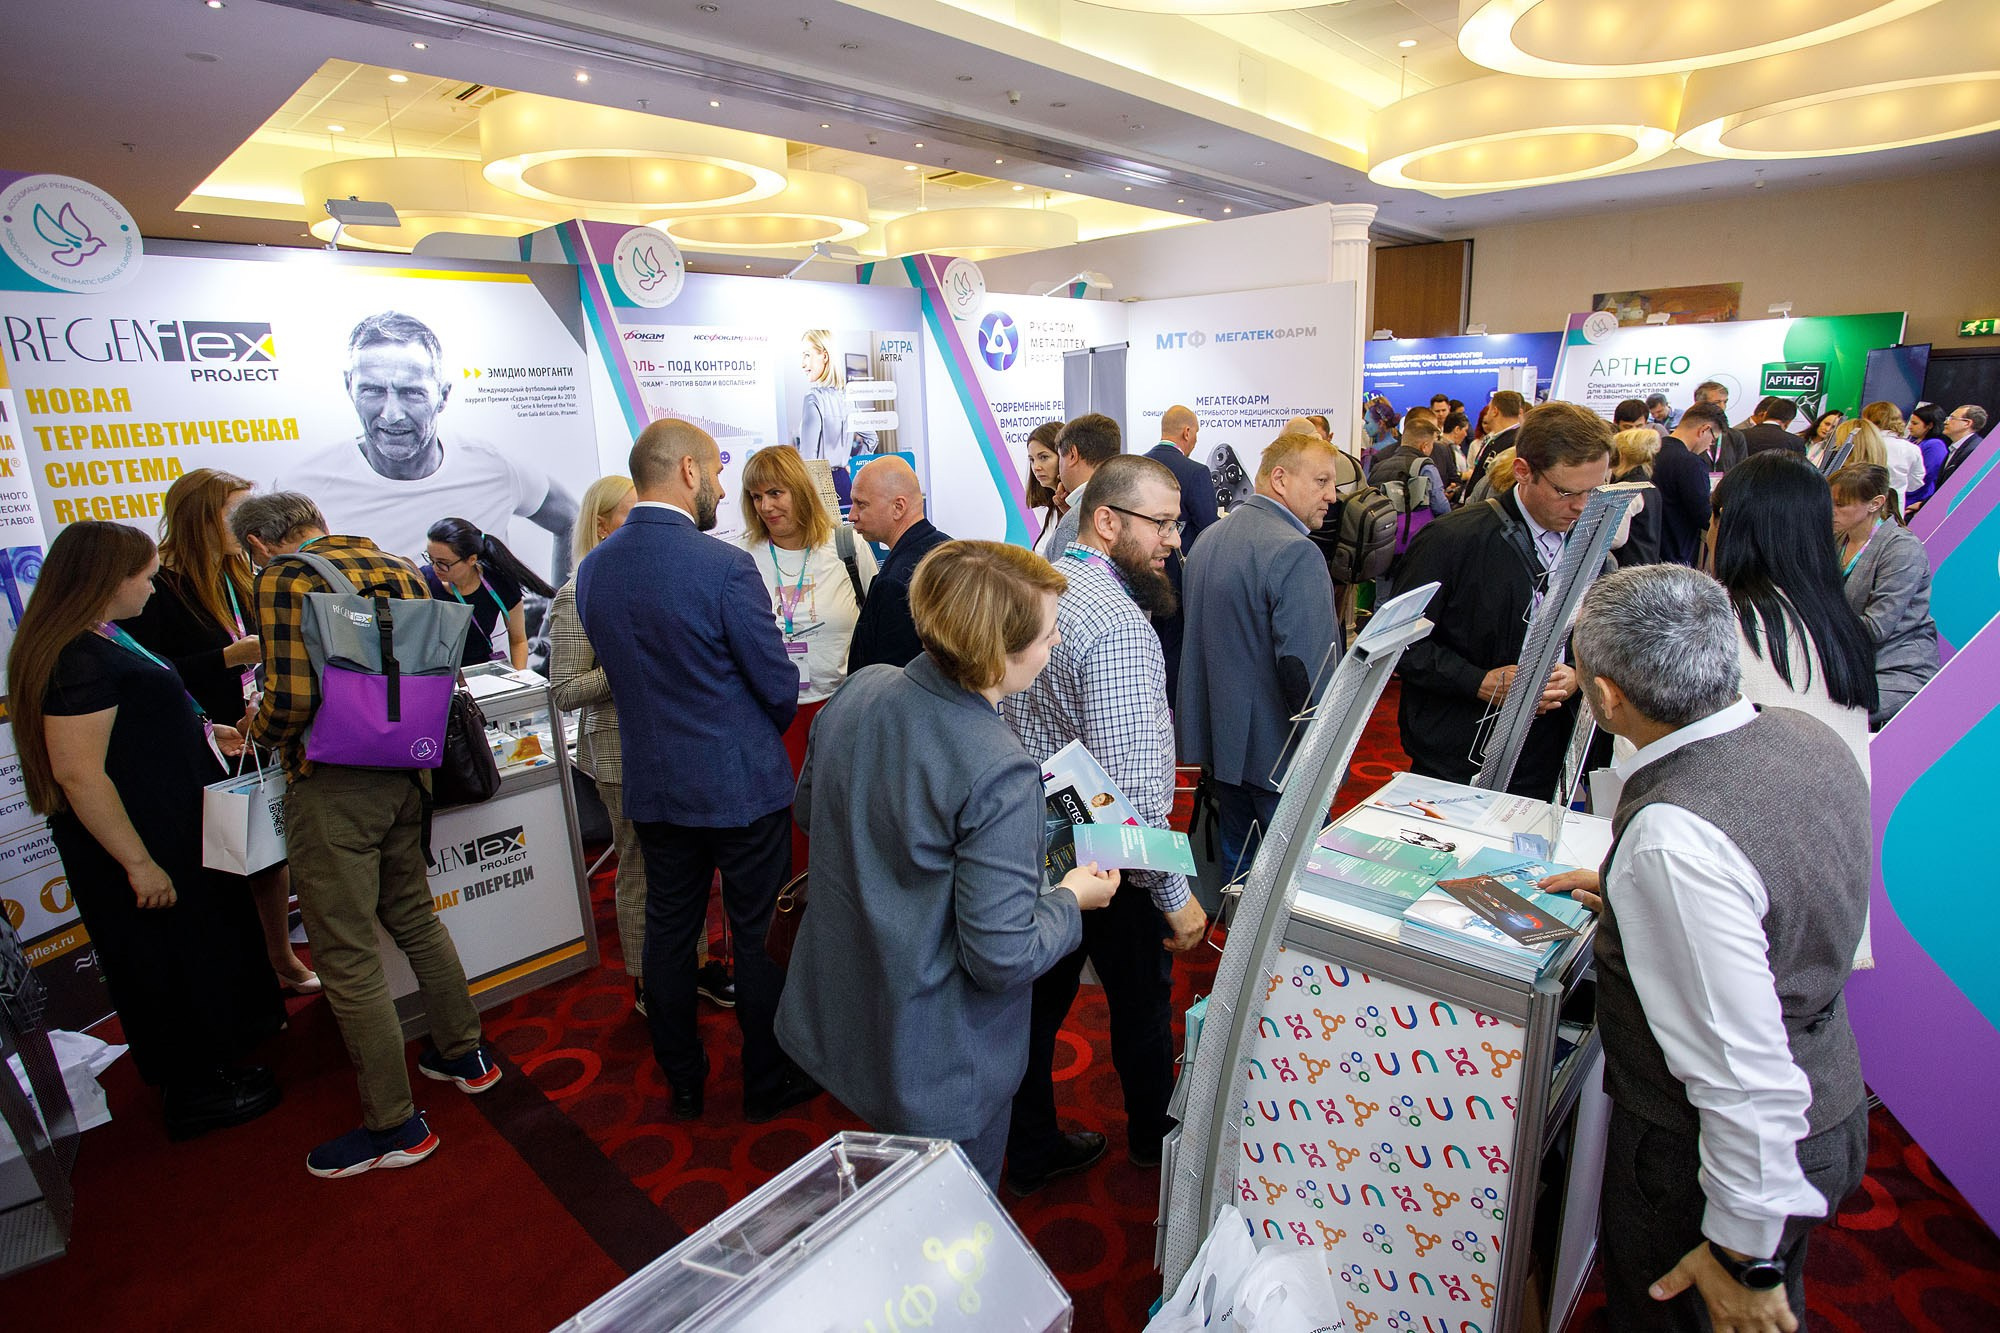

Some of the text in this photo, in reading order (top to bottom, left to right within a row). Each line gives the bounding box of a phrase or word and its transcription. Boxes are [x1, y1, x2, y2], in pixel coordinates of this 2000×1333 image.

[1030, 321, 1074, 333] РУСАТОМ
[1030, 338, 1086, 349] МЕТАЛЛТЕХ
[1156, 326, 1317, 349] МТФ МЕГАТЕКФАРМ
[880, 340, 913, 353] АРТРА
[880, 354, 902, 362] ARTRA
[1438, 352, 1483, 360] ТЕХНОЛОГИИ
[668, 360, 692, 373] ПОД
[694, 360, 756, 371] КОНТРОЛЬ!
[1422, 359, 1462, 367] ОРТОПЕДИИ
[1590, 355, 1691, 377] АРТНЕО
[190, 368, 279, 382] PROJECT
[488, 367, 573, 379] ЭМИДИО МОРГАНТИ
[525, 385, 557, 393] футбольный
[25, 388, 132, 415] НОВАЯ
[1196, 394, 1270, 406] МЕГАТЕКФАРМ
[1240, 407, 1290, 416] МЕДИЦИНСКОЙ
[1291, 408, 1334, 416] ПРОДУКЦИИ
[1200, 419, 1242, 428] РУСАТОМ
[33, 418, 300, 451] ТЕРАПЕВТИЧЕСКАЯ
[45, 456, 184, 488] СИСТЕМА
[480, 851, 527, 872] PROJECT
[463, 865, 535, 902] ВПЕРЕДИ
